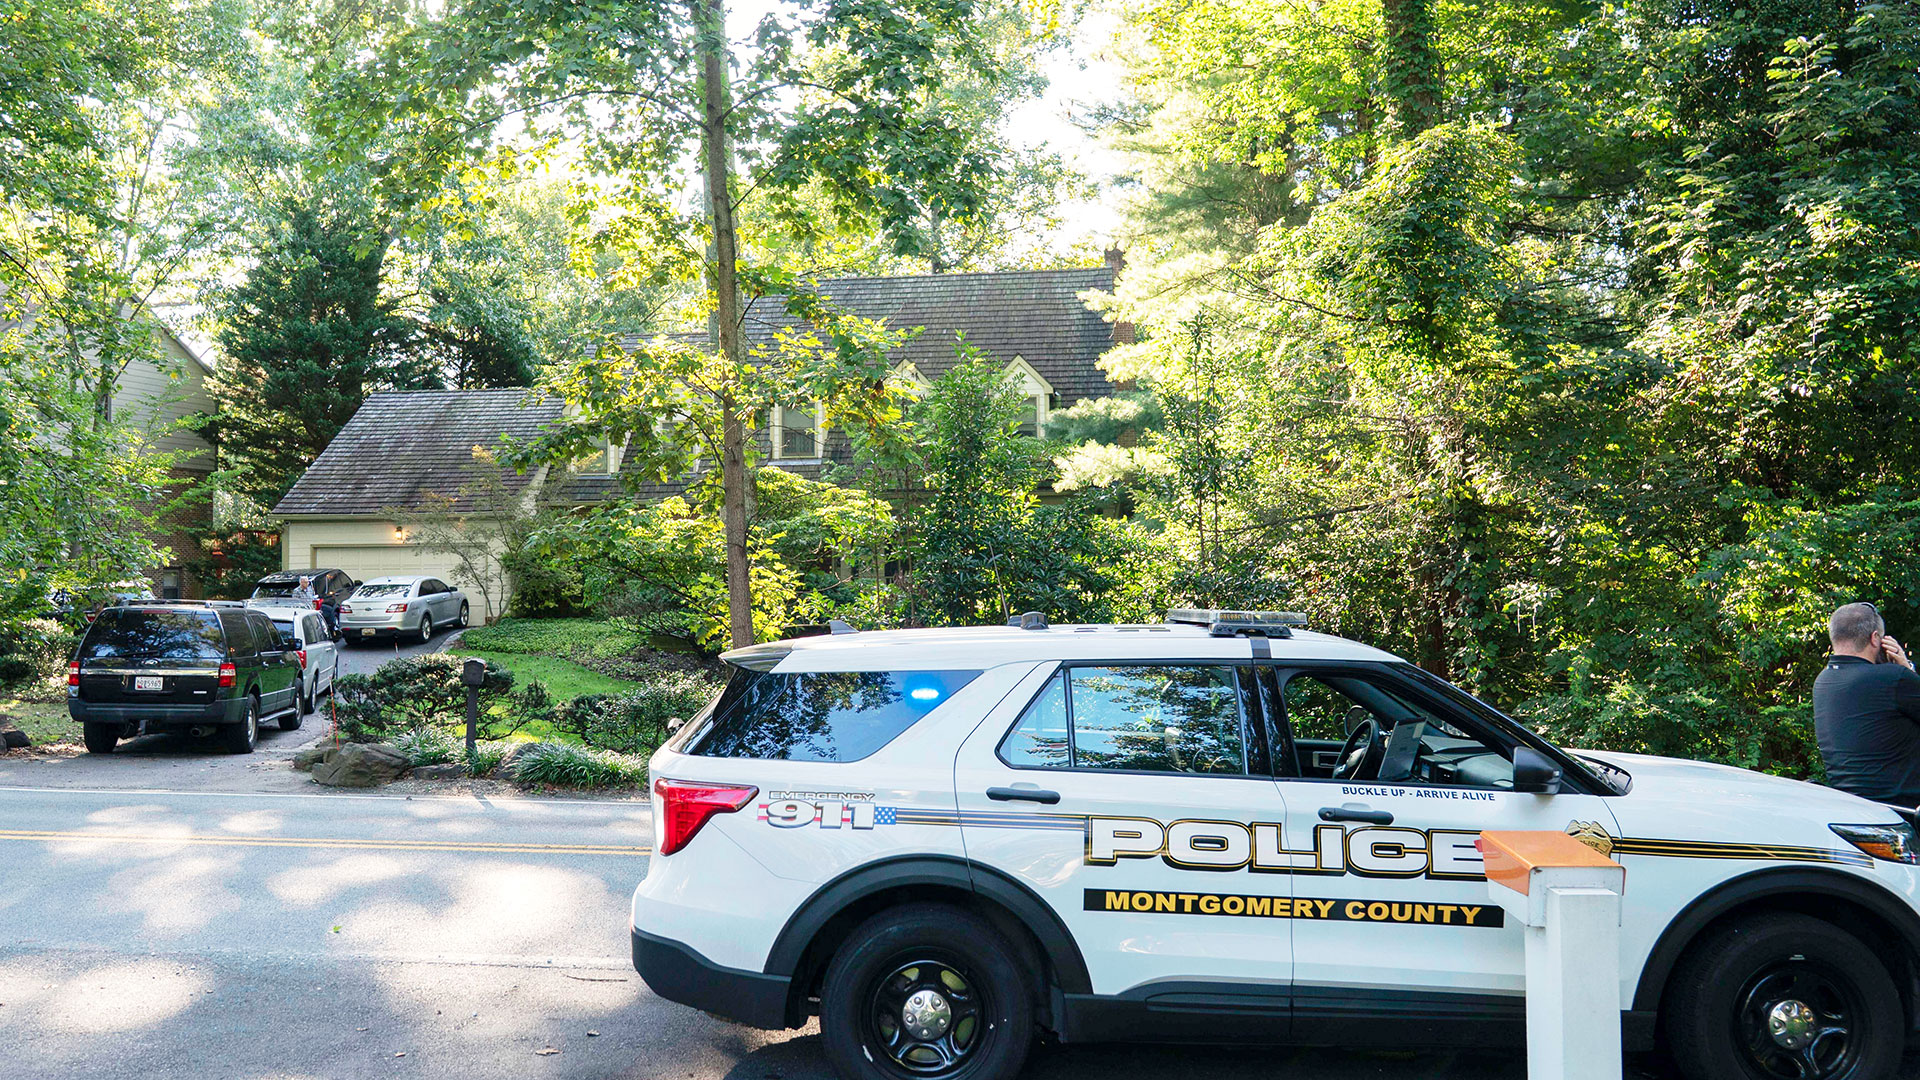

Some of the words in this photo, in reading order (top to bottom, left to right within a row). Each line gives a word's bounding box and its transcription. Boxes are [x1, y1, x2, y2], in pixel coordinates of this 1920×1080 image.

[769, 791, 875, 801] EMERGENCY
[1342, 786, 1388, 797] BUCKLE
[1391, 788, 1406, 797] UP
[1416, 789, 1459, 800] ARRIVE
[1462, 791, 1496, 801] ALIVE
[766, 799, 875, 830] 911
[1084, 815, 1488, 881] POLICE
[1105, 889, 1336, 919] MONTGOMERY
[1345, 900, 1482, 925] COUNTY
